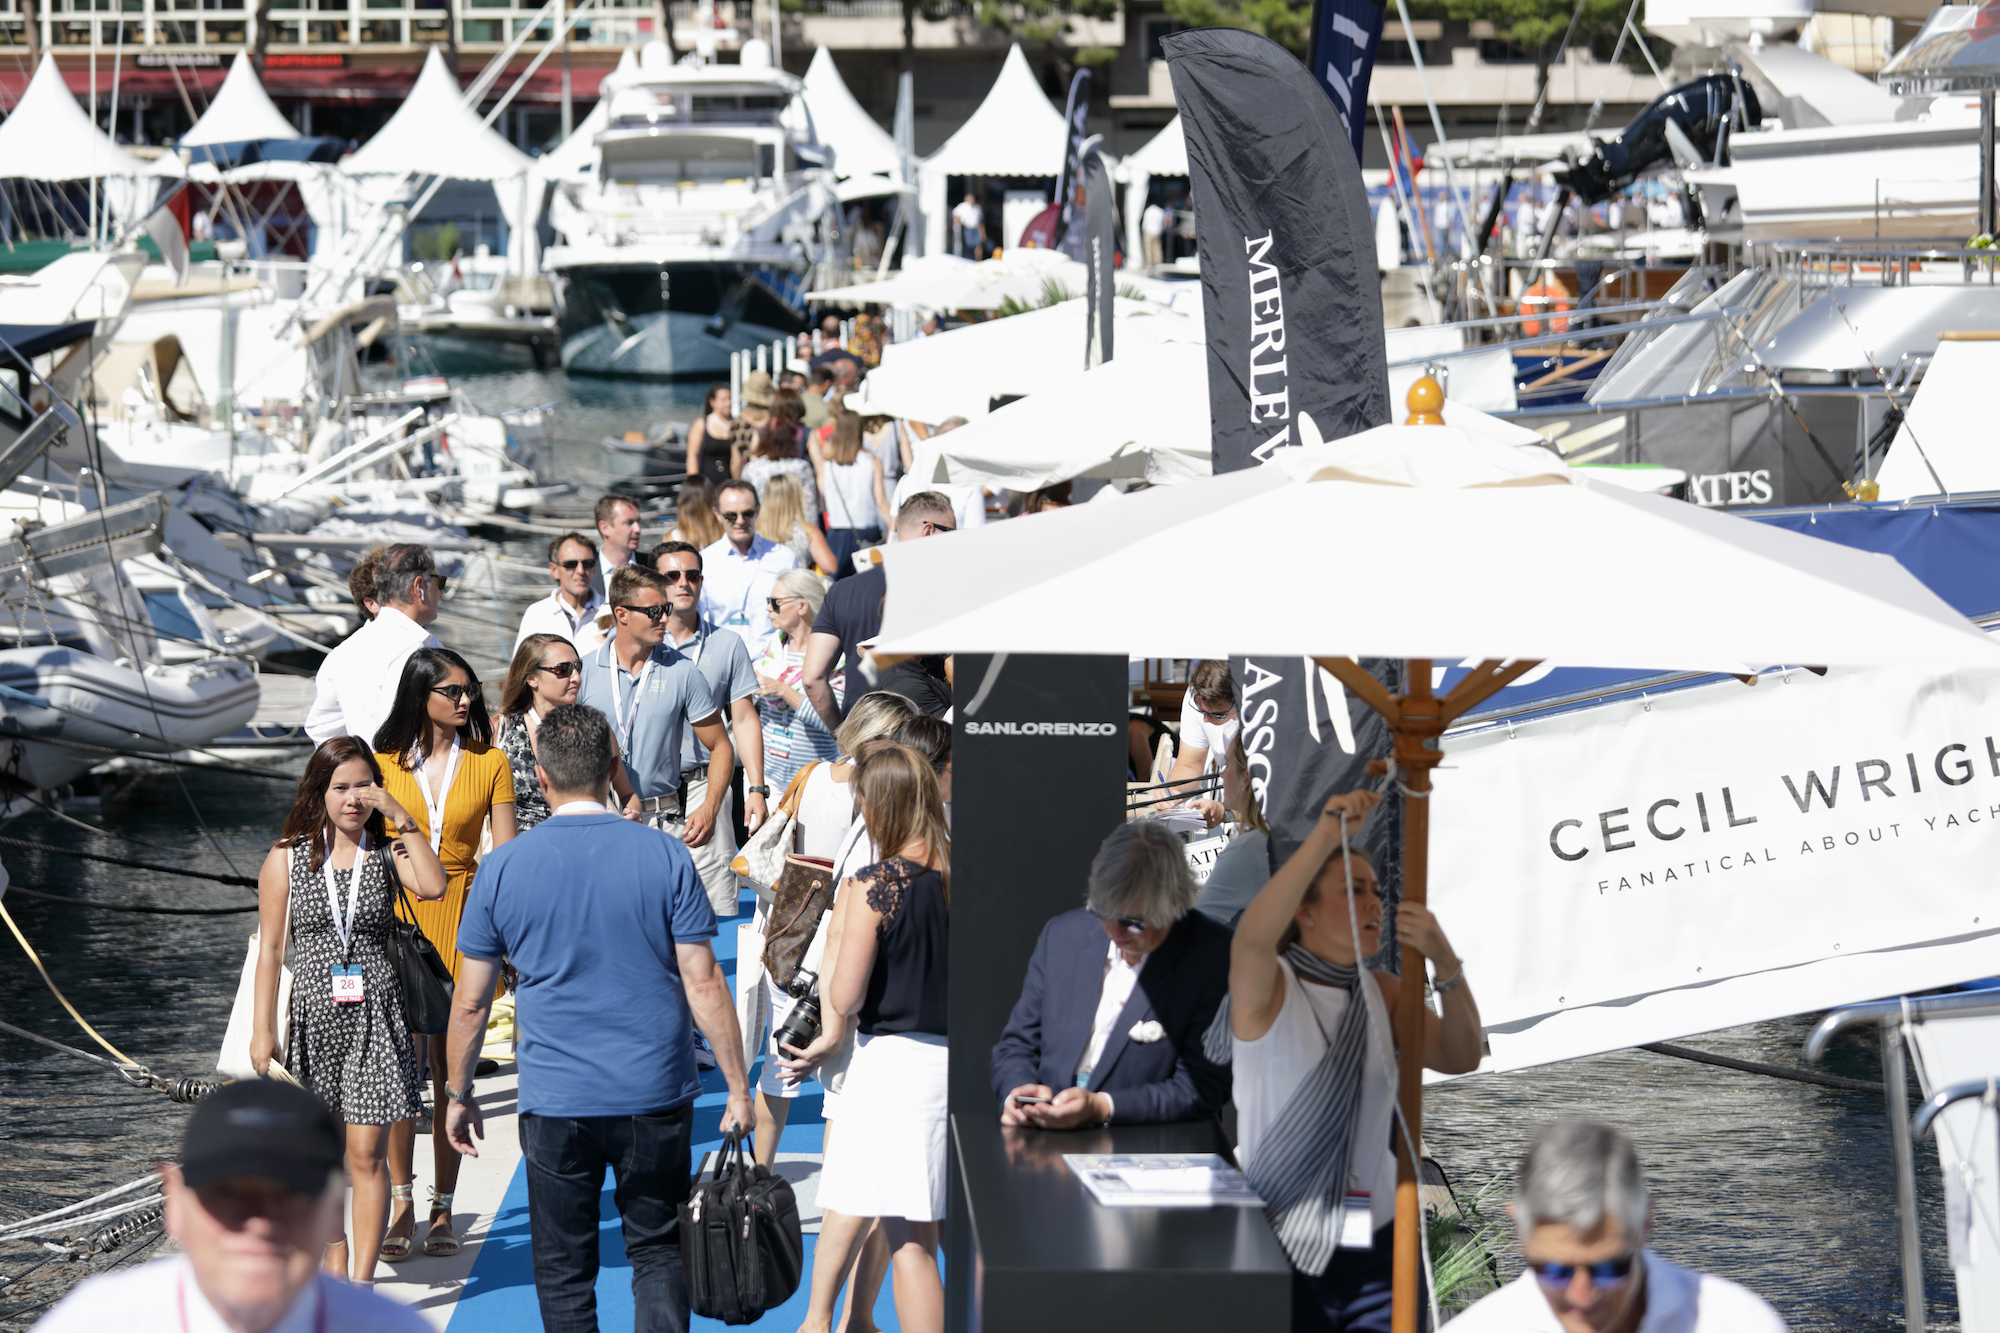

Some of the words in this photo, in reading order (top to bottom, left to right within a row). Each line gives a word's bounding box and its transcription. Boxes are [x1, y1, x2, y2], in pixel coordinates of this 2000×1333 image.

[964, 721, 1118, 736] SANLORENZO
[1549, 786, 1758, 862] CECIL
[1598, 847, 1777, 895] FANATICAL
[1799, 822, 1903, 855] ABOUT
[340, 979, 355, 989] 28
